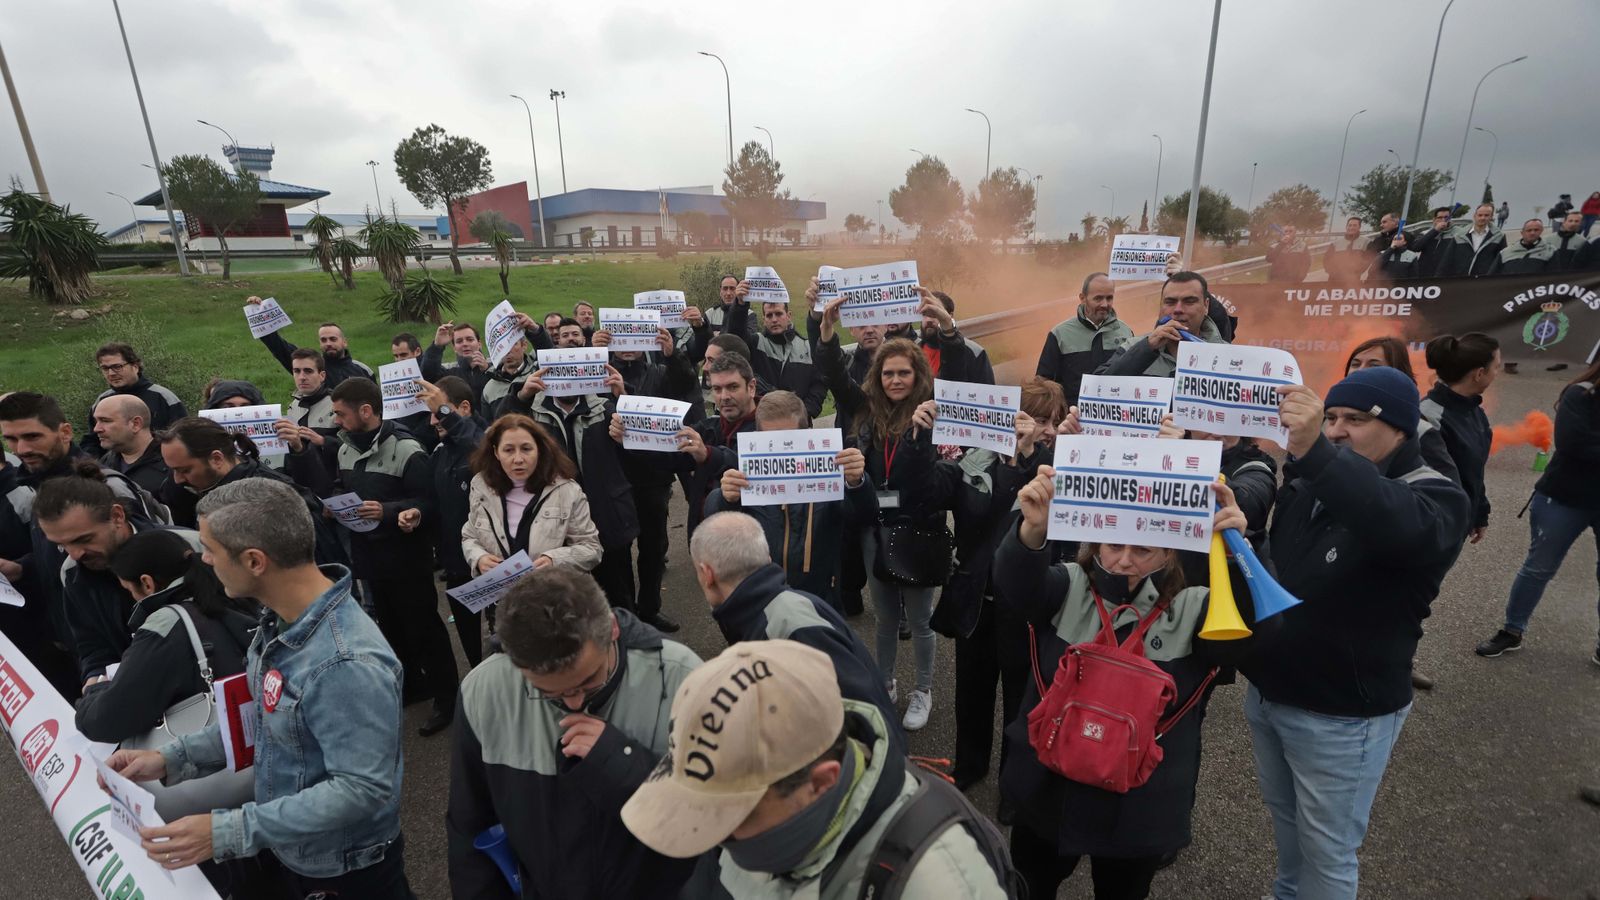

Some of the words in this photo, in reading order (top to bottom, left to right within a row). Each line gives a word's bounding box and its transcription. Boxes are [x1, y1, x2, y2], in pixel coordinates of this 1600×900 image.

[1284, 289, 1310, 301] TU
[1316, 285, 1441, 301] ABANDONO
[1304, 304, 1333, 316] ME
[1339, 303, 1412, 316] PUEDE
[684, 659, 773, 782] Vienna
[75, 822, 114, 866] CSIF
